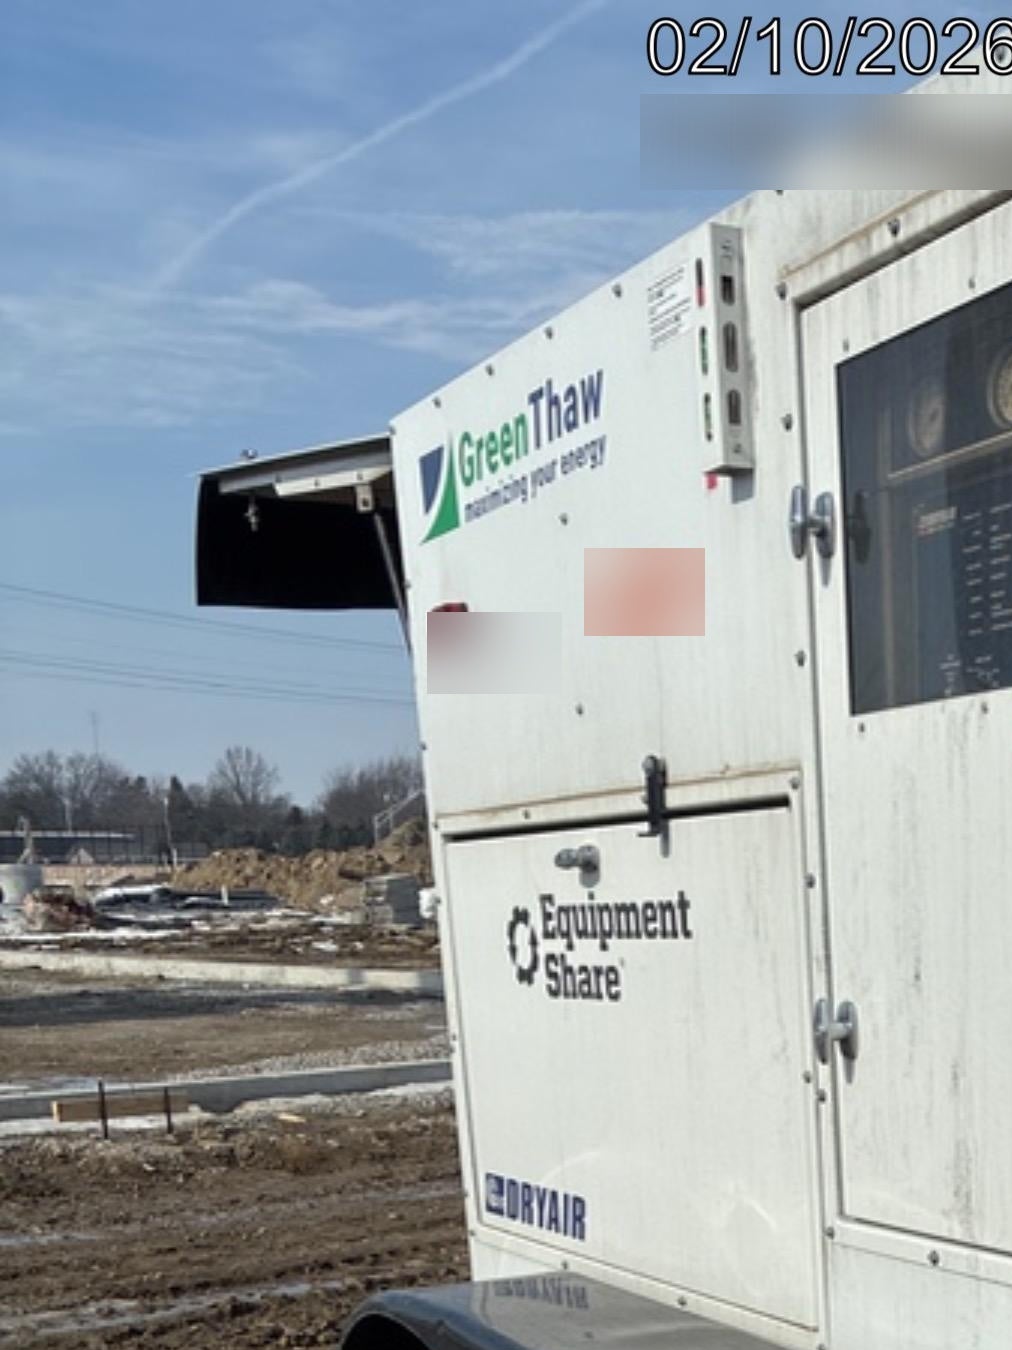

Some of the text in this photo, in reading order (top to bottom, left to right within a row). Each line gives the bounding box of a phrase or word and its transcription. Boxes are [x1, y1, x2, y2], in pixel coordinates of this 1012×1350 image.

[458, 369, 604, 488] GreenThaw
[464, 434, 607, 523] maximizing your energy
[539, 890, 693, 951] Equipment
[544, 952, 622, 1001] Share
[506, 1178, 586, 1242] DRYAIR
